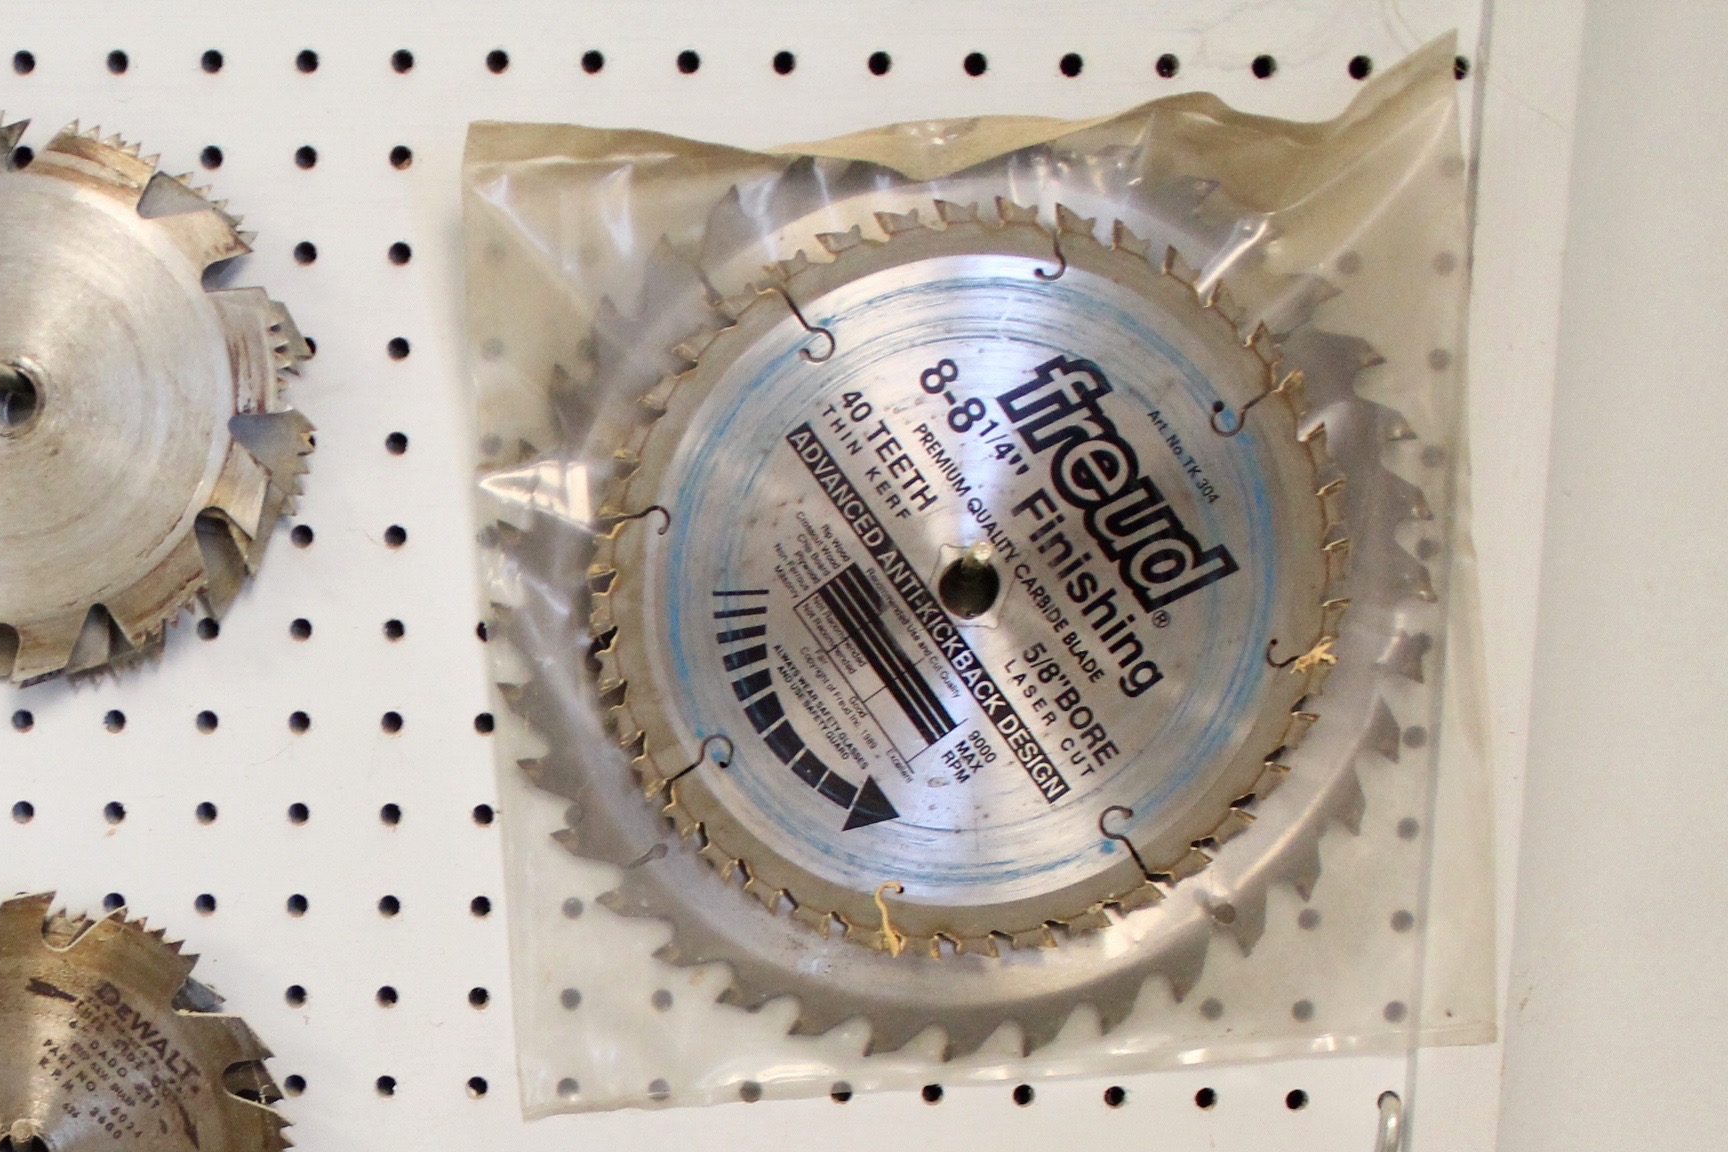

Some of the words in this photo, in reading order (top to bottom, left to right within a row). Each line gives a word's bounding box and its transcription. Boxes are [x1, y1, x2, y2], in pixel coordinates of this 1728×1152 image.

[821, 402, 863, 456] THIN
[864, 466, 911, 519] KERF
[841, 390, 872, 423] 40
[865, 418, 938, 512] TEETH
[1146, 409, 1168, 432] Art.
[1182, 455, 1202, 479] TK
[1195, 477, 1219, 504] 304
[996, 354, 1240, 614] freud
[793, 549, 821, 584] Plywood
[796, 532, 813, 553] Chip
[809, 551, 831, 577] Board
[820, 544, 841, 570] Wood
[831, 537, 851, 562] Wood
[912, 422, 971, 497] PREMIUM
[966, 496, 1021, 564] QUALITY
[1013, 562, 1069, 633] CARBIDE
[1061, 630, 1105, 683] BLADE
[774, 564, 799, 599] Masonry
[1011, 487, 1164, 698] Finishing
[788, 430, 884, 547] ADVANCED
[876, 549, 1006, 716] ANTI-KICKBACK
[997, 712, 1064, 798] DESIGN
[802, 602, 815, 618] Not
[812, 616, 856, 674] Recommended
[813, 593, 825, 611] Not
[822, 608, 868, 667] Recommended
[799, 645, 830, 684] Copyright
[824, 682, 837, 692] of
[832, 690, 853, 715] Freud
[814, 647, 828, 664] Fair
[917, 641, 932, 657] and
[938, 669, 961, 698] Quality
[772, 644, 799, 677] ALWAYS
[797, 676, 818, 701] WEAR
[815, 700, 842, 732] SAFETY
[837, 731, 868, 770] GLASSES
[776, 665, 793, 683] AND
[789, 682, 805, 698] USE
[803, 699, 829, 730] SAFETY
[824, 730, 849, 760] GUARD
[848, 695, 868, 718] Good
[1003, 657, 1057, 726] LASER
[1059, 736, 1096, 776] CUT
[884, 746, 913, 783] Excellent
[940, 748, 971, 783] RPM
[955, 739, 984, 773] MAX
[968, 729, 997, 763] 9000
[42, 1038, 76, 1070] PART
[88, 1039, 127, 1078] DADO
